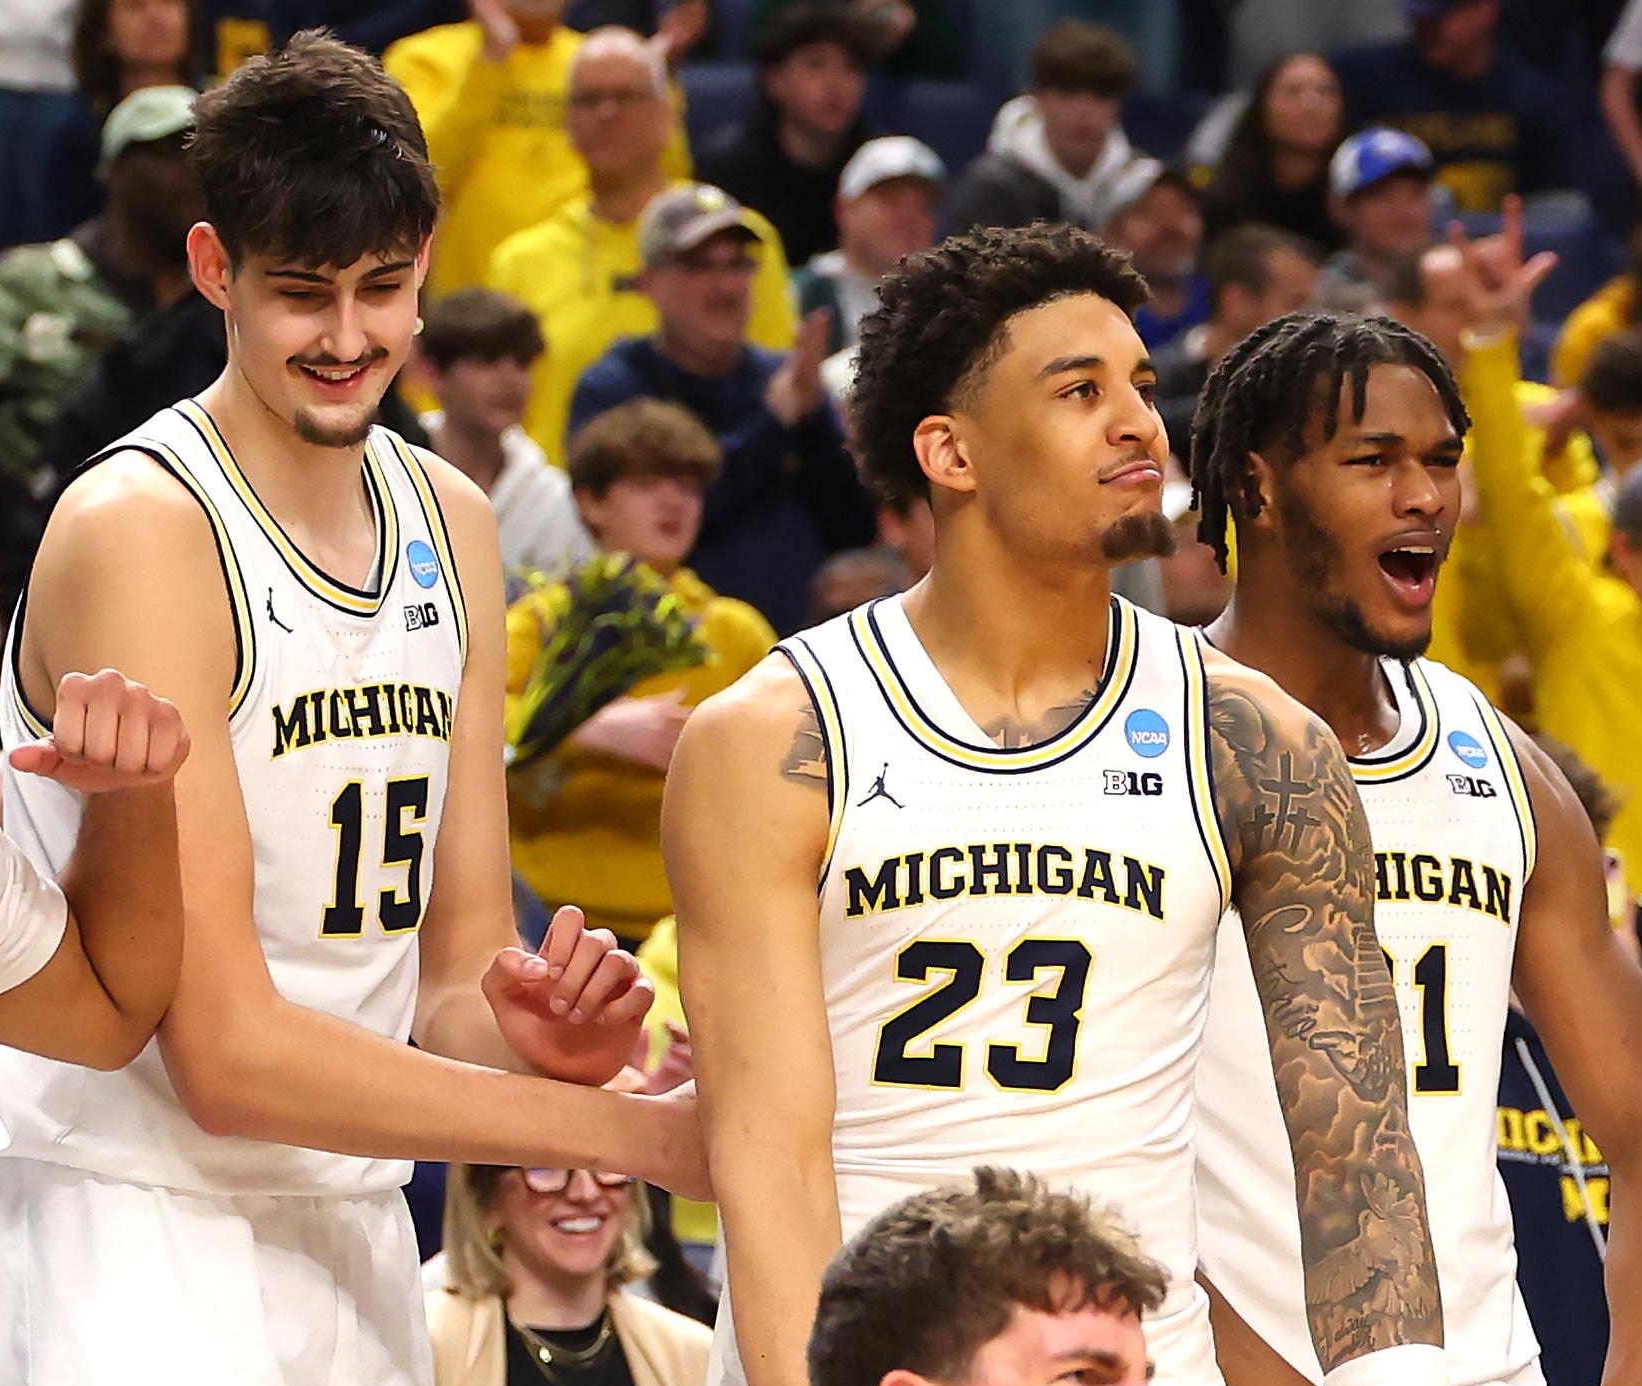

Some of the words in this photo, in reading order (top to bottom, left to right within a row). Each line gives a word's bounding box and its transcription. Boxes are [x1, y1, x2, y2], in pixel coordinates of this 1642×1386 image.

[1131, 729, 1169, 747] NCAA
[319, 774, 431, 939] 15
[842, 841, 1168, 923] MICHIGAN
[870, 936, 1096, 1093] 23
[1380, 940, 1462, 1096] 1
